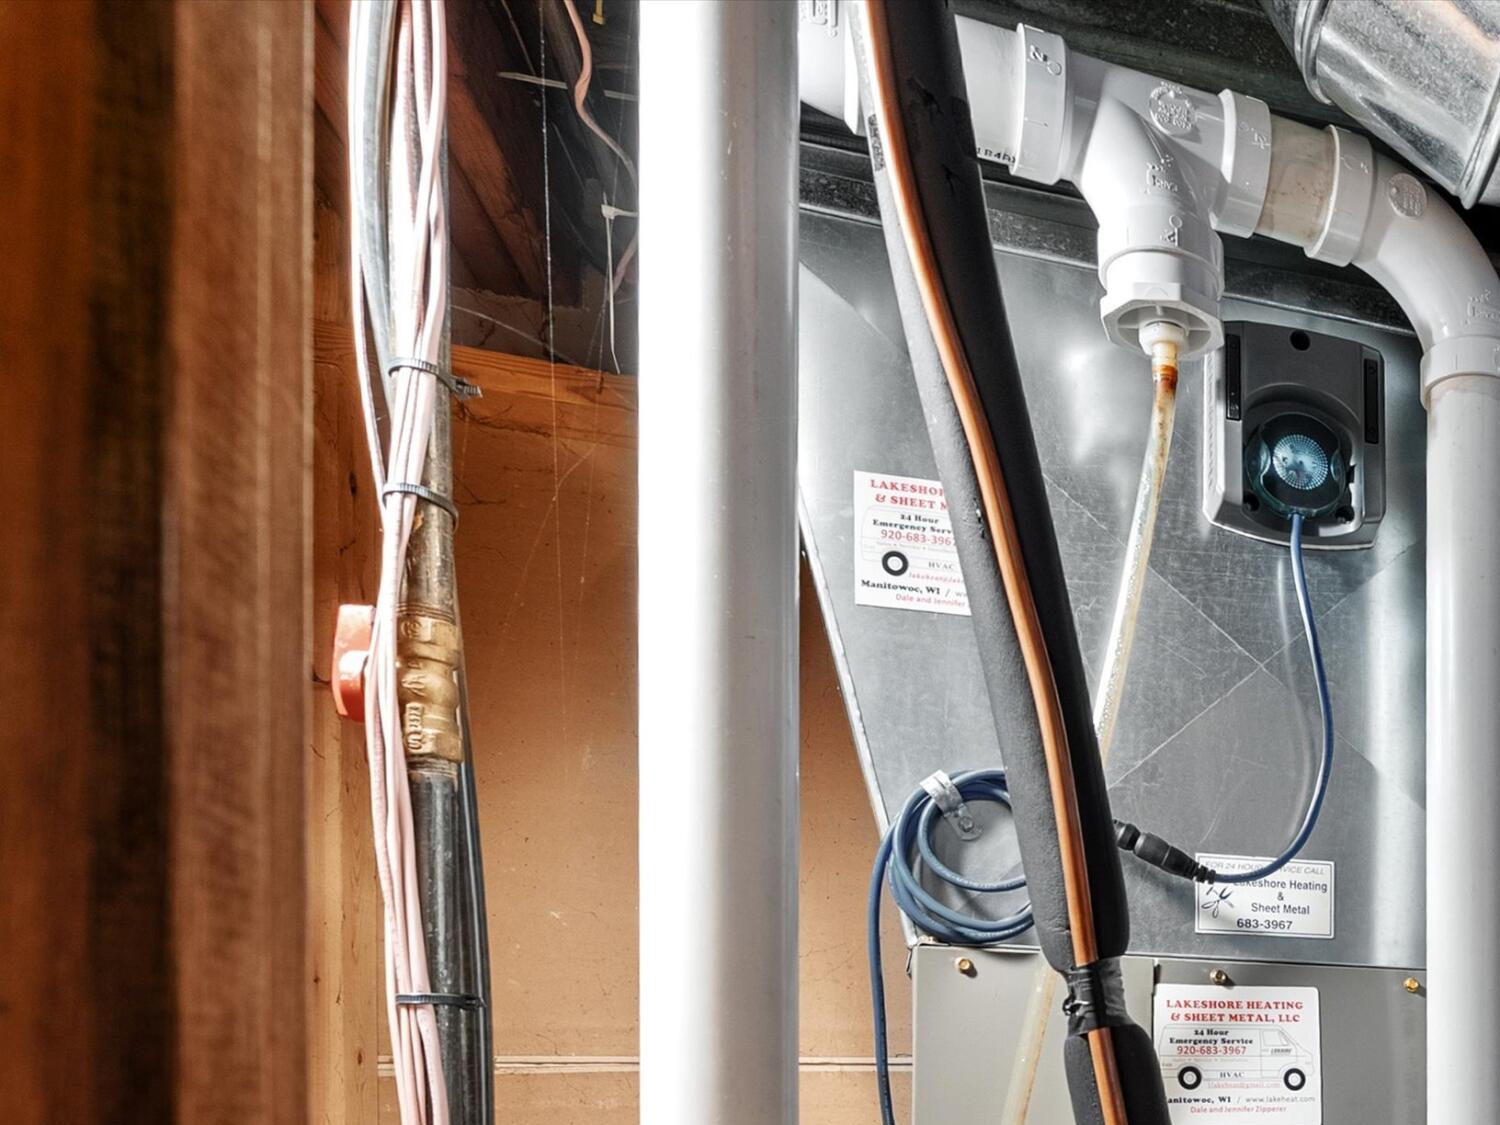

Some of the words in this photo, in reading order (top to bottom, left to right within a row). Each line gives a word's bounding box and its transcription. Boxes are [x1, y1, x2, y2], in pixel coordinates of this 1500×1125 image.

[876, 494, 885, 503] &
[891, 496, 936, 509] SHEET
[915, 514, 939, 524] Hour
[873, 519, 927, 532] Emergency
[930, 526, 951, 534] Serv
[881, 530, 956, 546] 920-683-396
[861, 579, 923, 594] Manitowoc,
[926, 586, 941, 595] WI
[1304, 867, 1325, 875] CALL
[1289, 880, 1328, 893] Heating
[1277, 892, 1284, 901] &
[1252, 903, 1280, 913] Sheet
[1283, 904, 1310, 915] Metal
[1237, 918, 1293, 930] 683-3967
[1167, 1000, 1243, 1010] LAKESHORE
[1247, 1001, 1303, 1010] HEATING
[1171, 1013, 1181, 1022] &
[1185, 1013, 1225, 1022] SHEET
[1229, 1014, 1275, 1024] METAL,
[1279, 1014, 1300, 1023] LLC
[1170, 1037, 1218, 1045] Emergency
[1177, 1046, 1247, 1055] 920-683-3967
[1167, 1096, 1214, 1104] anitowoc,
[1225, 1105, 1254, 1113] Jennifer
